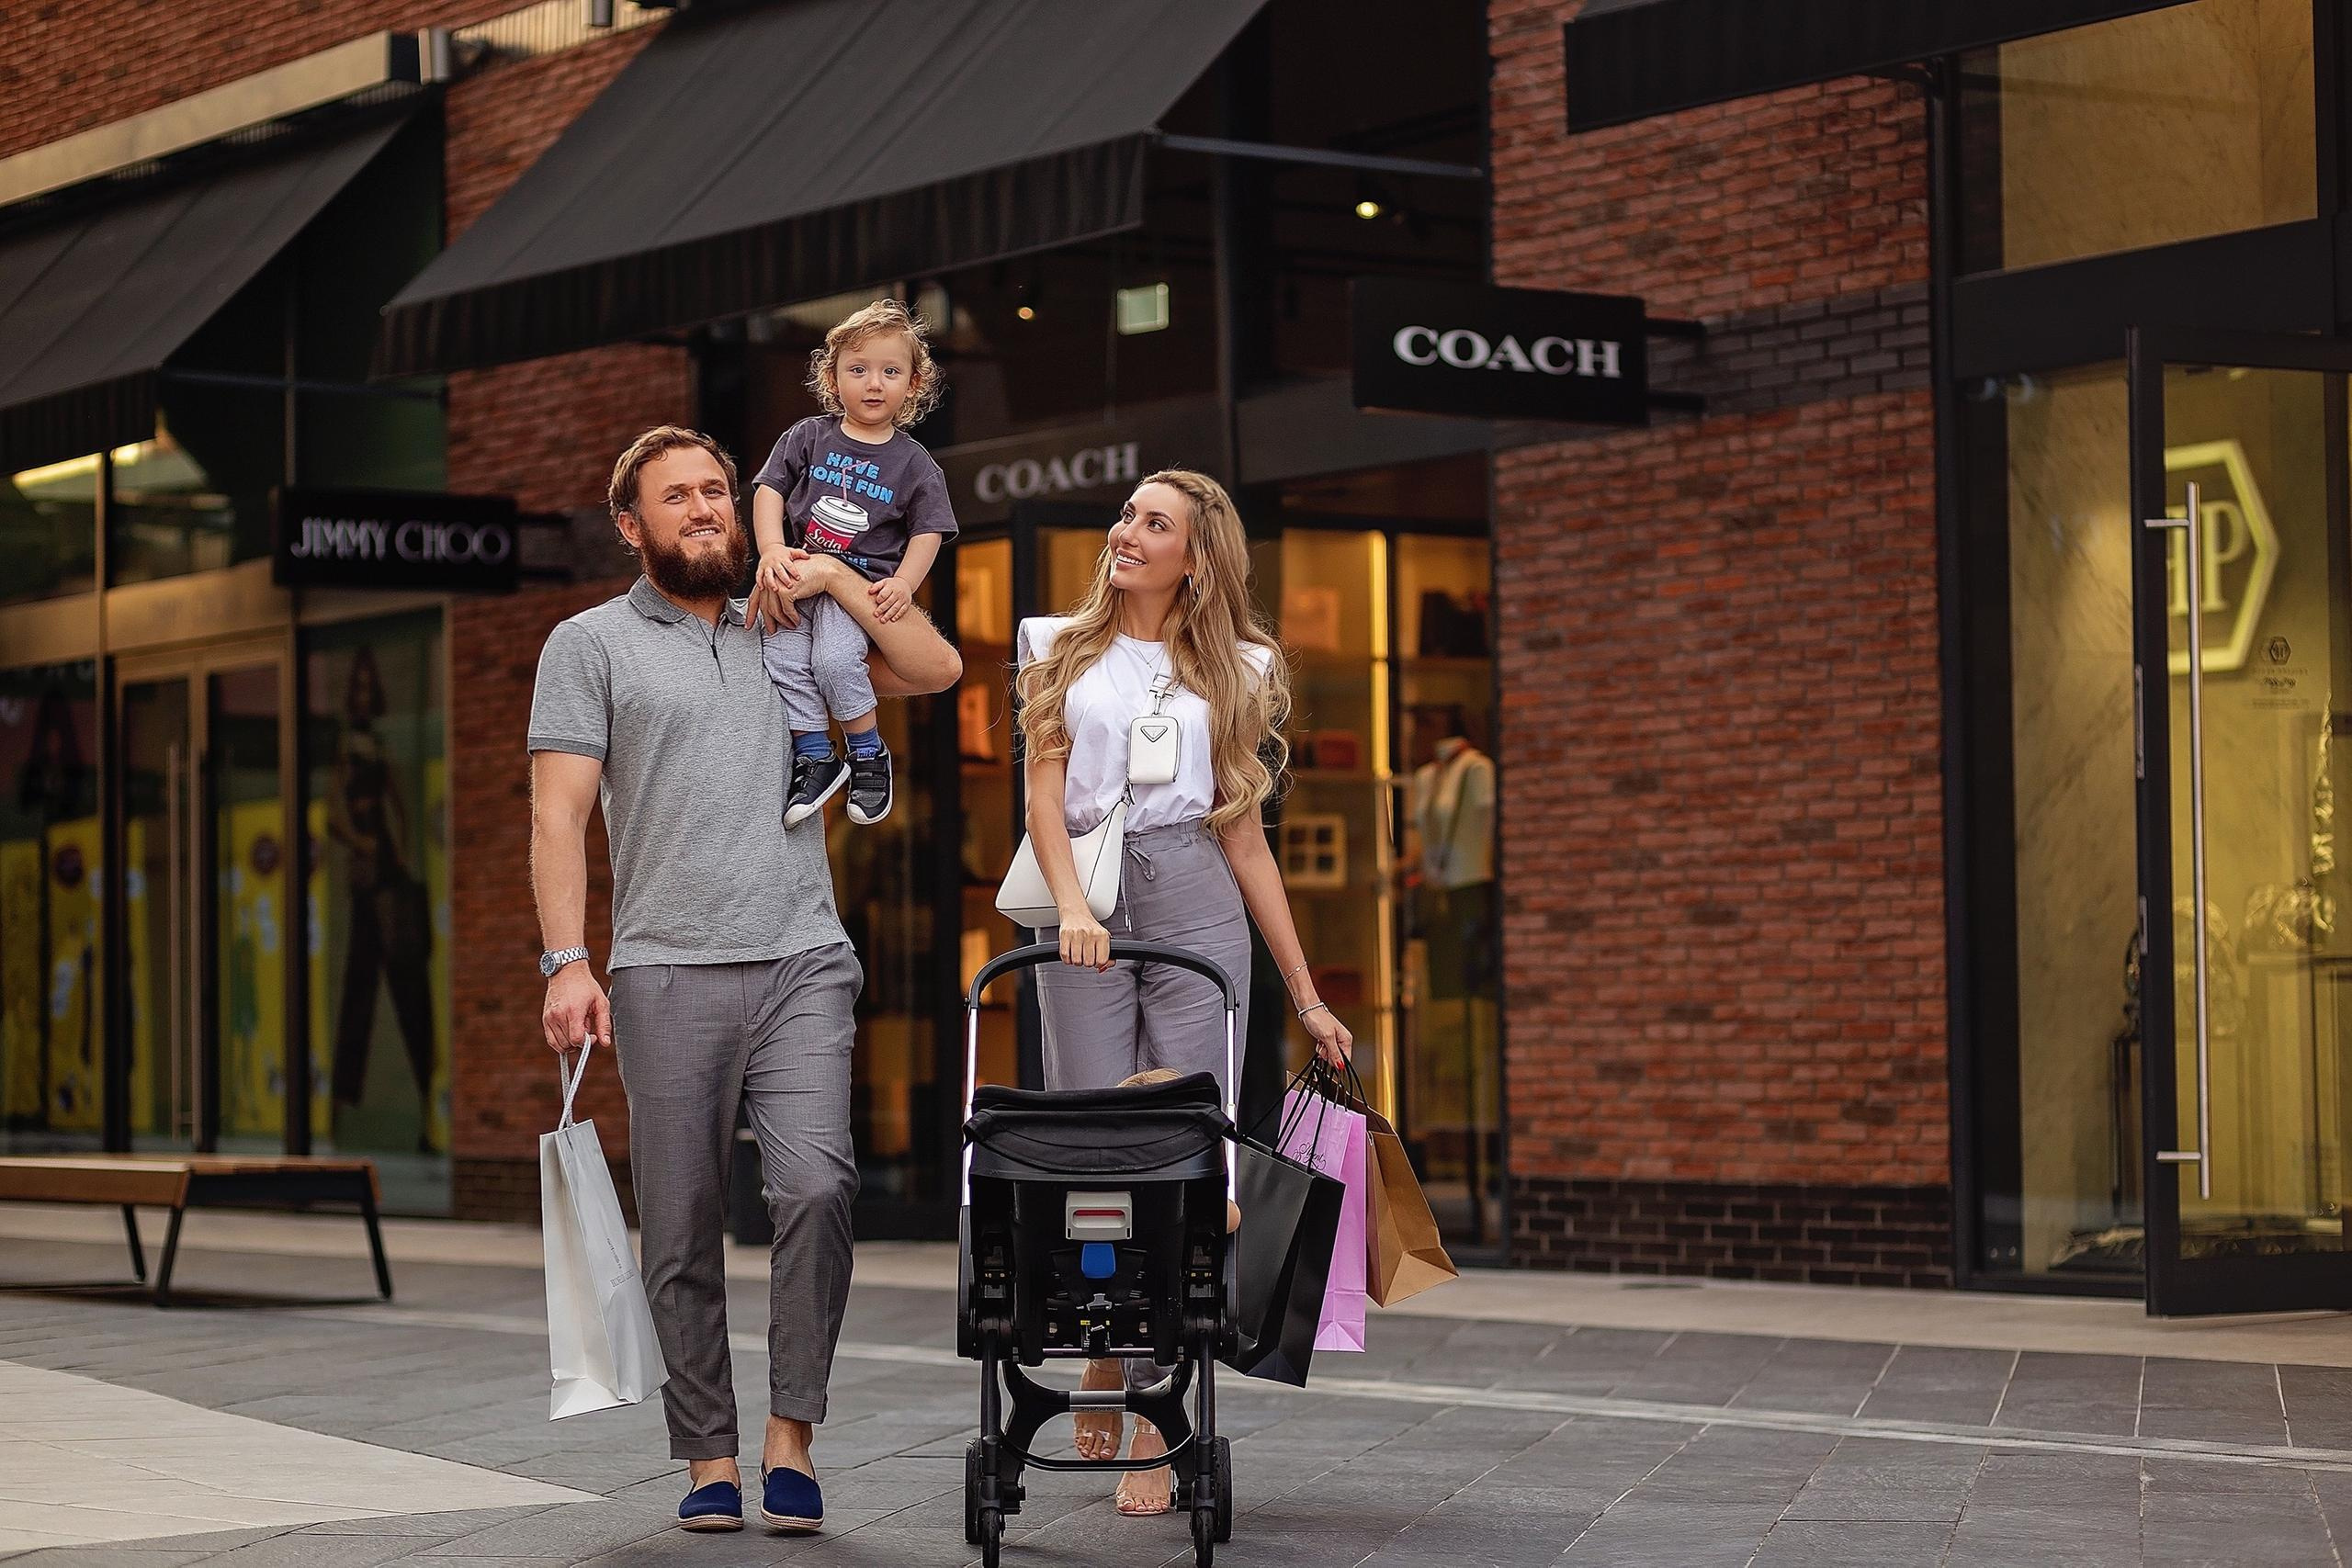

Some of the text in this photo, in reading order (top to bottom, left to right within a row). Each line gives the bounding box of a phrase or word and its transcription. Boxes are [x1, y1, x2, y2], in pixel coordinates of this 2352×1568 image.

[1392, 324, 1622, 378] COACH
[825, 451, 880, 480] HAVE
[974, 442, 1138, 503] COACH
[854, 479, 895, 504] FUN
[290, 516, 512, 566] JIMMY CHOO
[808, 528, 842, 550] Soda
